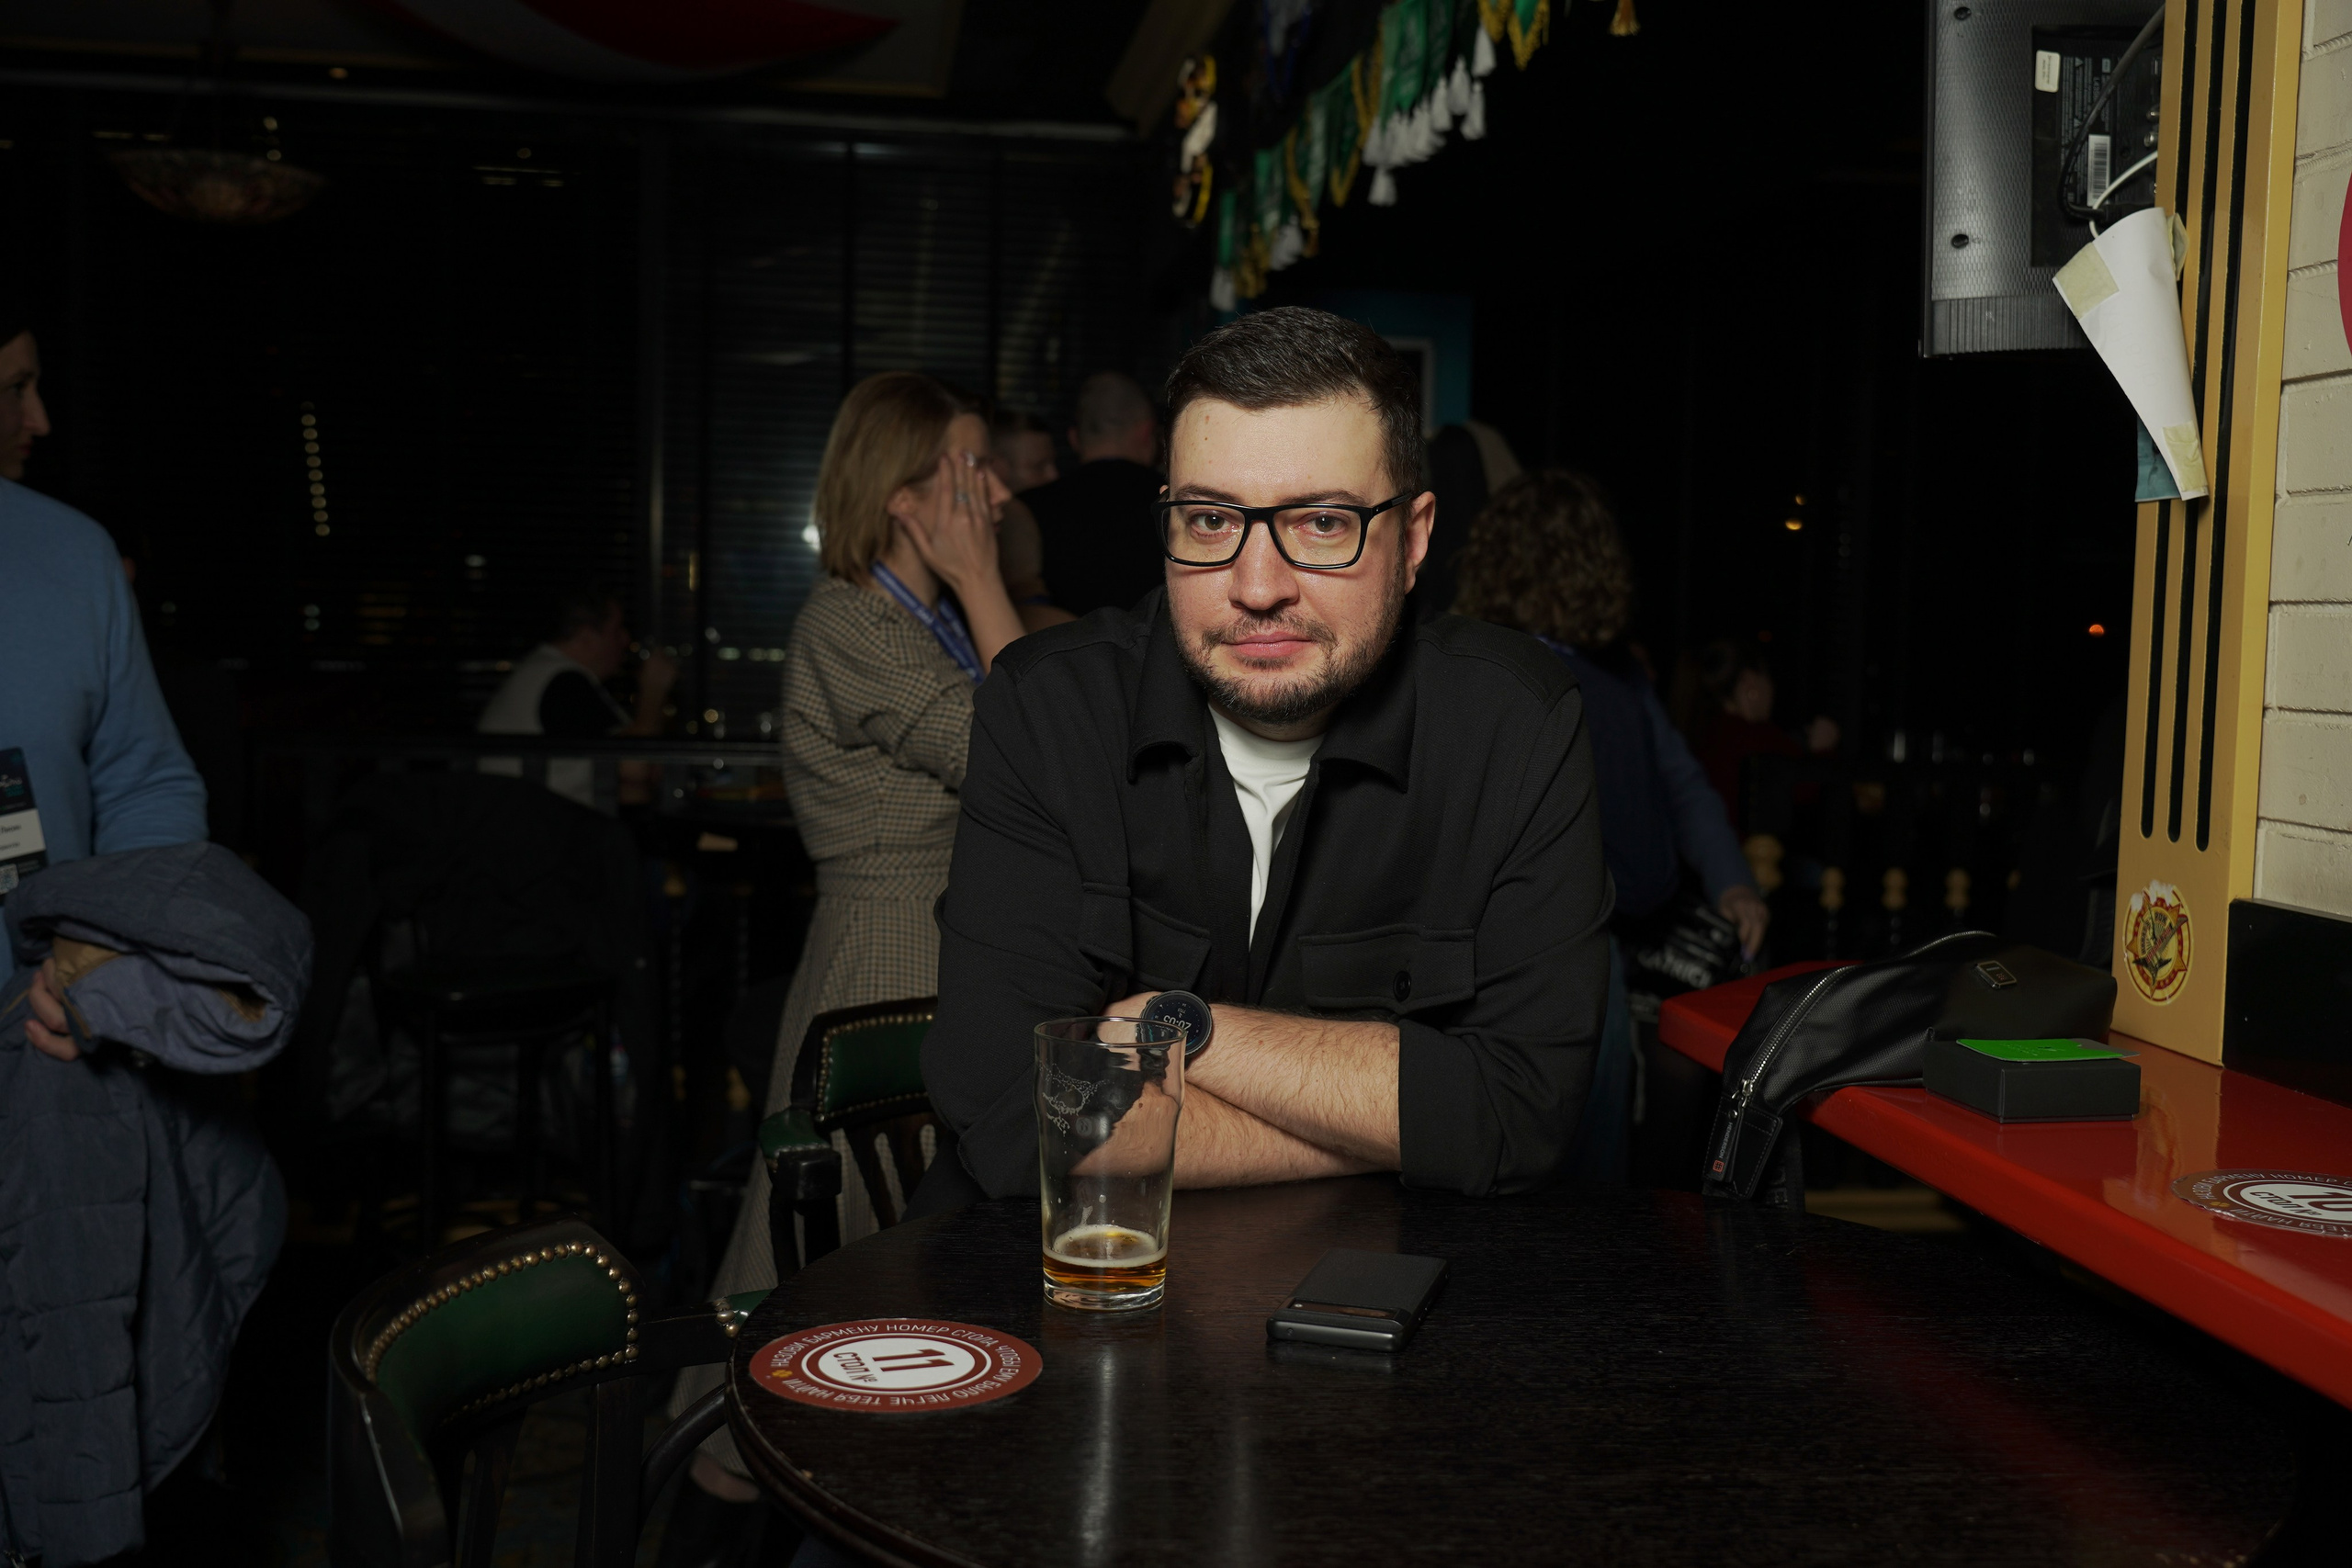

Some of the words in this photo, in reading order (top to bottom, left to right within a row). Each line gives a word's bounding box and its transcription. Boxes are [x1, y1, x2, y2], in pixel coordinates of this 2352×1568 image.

[1718, 1122, 1734, 1158] HENDERSON
[2269, 1173, 2338, 1183] НОМЕР
[2249, 1191, 2304, 1209] СТОЛ
[802, 1325, 878, 1344] БАРМЕНУ
[887, 1324, 950, 1334] НОМЕР
[771, 1341, 808, 1367] НАЗОВИ
[833, 1351, 871, 1374] СТОЛ
[872, 1348, 956, 1372] 11
[994, 1345, 1022, 1368] ЧТОБЫ
[992, 1368, 1020, 1383] ЕМУ
[782, 1378, 835, 1399] НАЙТИ
[952, 1380, 1001, 1399] БЫЛО
[833, 1393, 881, 1405] ТЕБЯ
[889, 1393, 951, 1406] ЛЕГЧЕ
